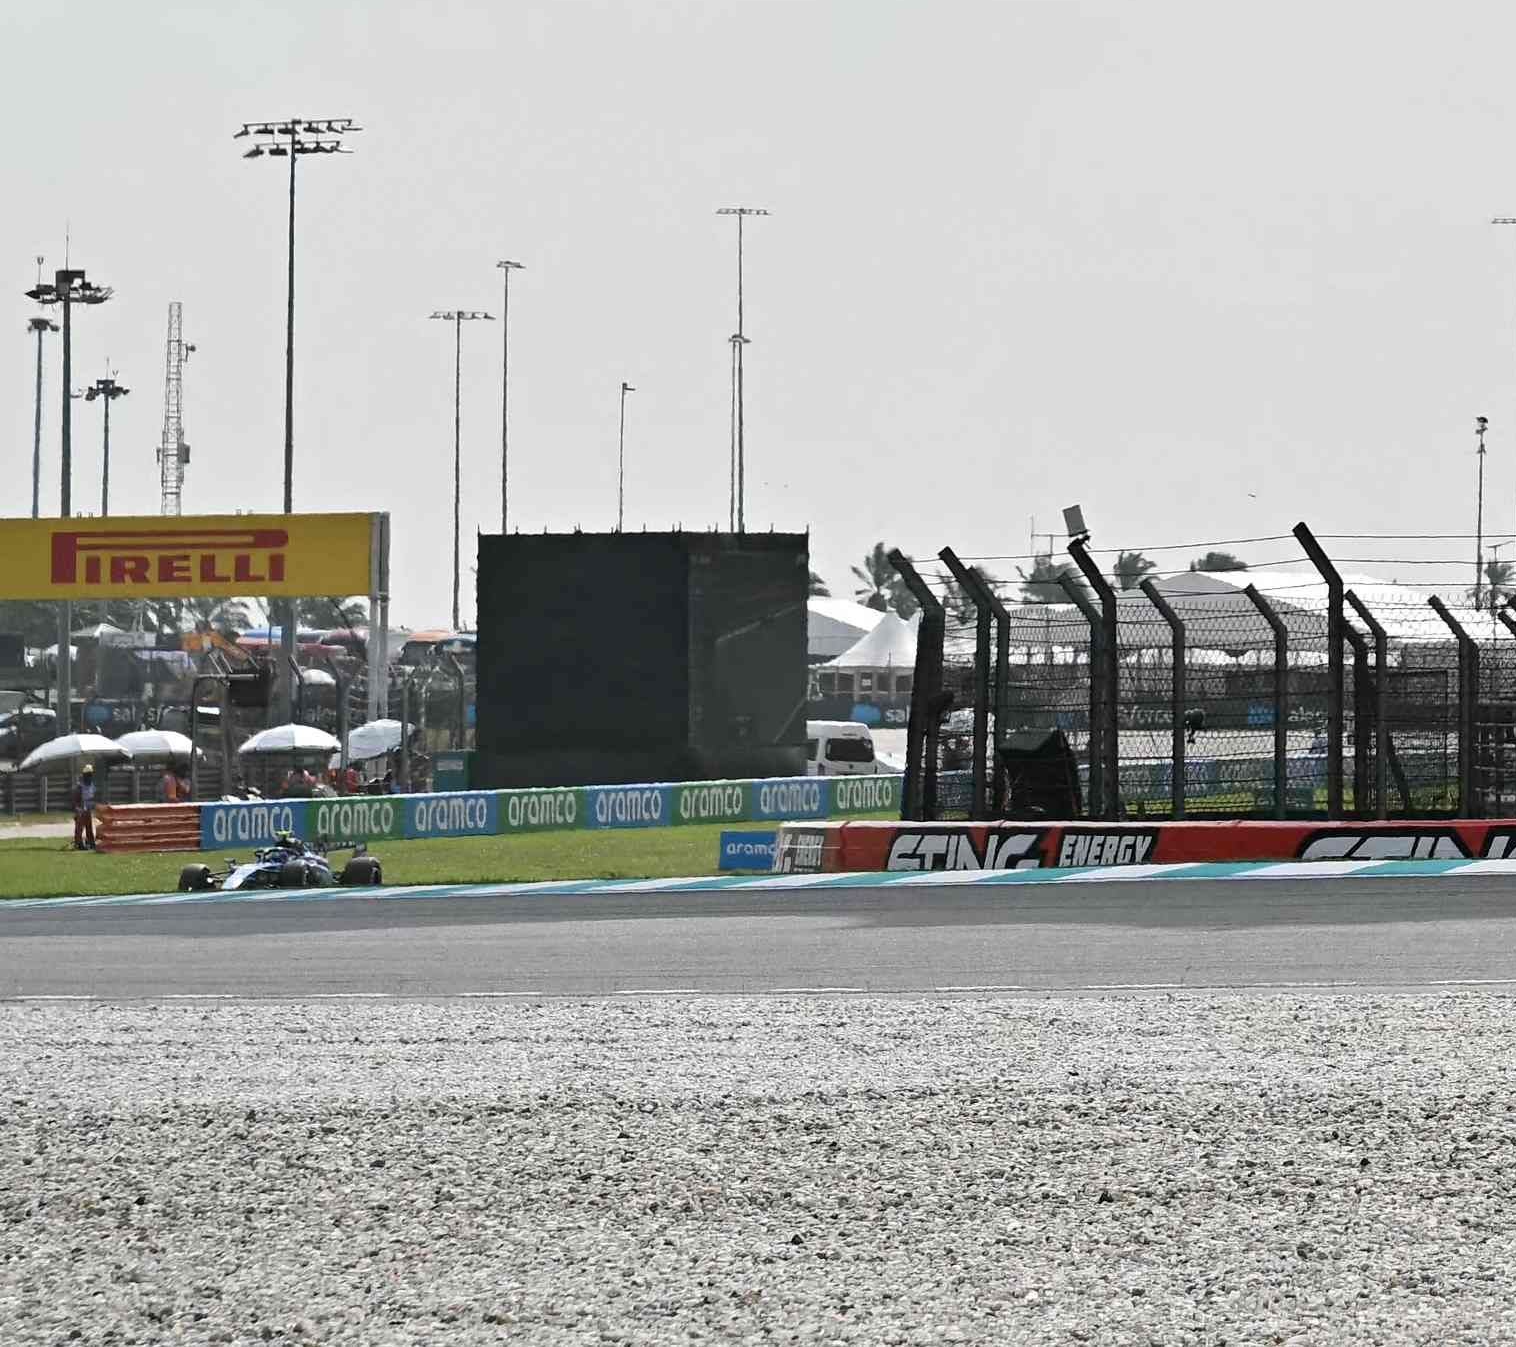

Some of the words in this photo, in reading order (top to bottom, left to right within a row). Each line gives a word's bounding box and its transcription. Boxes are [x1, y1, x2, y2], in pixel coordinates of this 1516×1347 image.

[51, 528, 289, 584] PIRELLI
[508, 792, 577, 827] aramco
[596, 789, 661, 822] aramco
[680, 785, 743, 818] aramco
[760, 784, 820, 814] aramco
[837, 777, 892, 810] aramco
[213, 806, 293, 842] aramco
[318, 802, 394, 835] aramco
[415, 798, 487, 831] aramco
[1058, 835, 1152, 868] ENERGY
